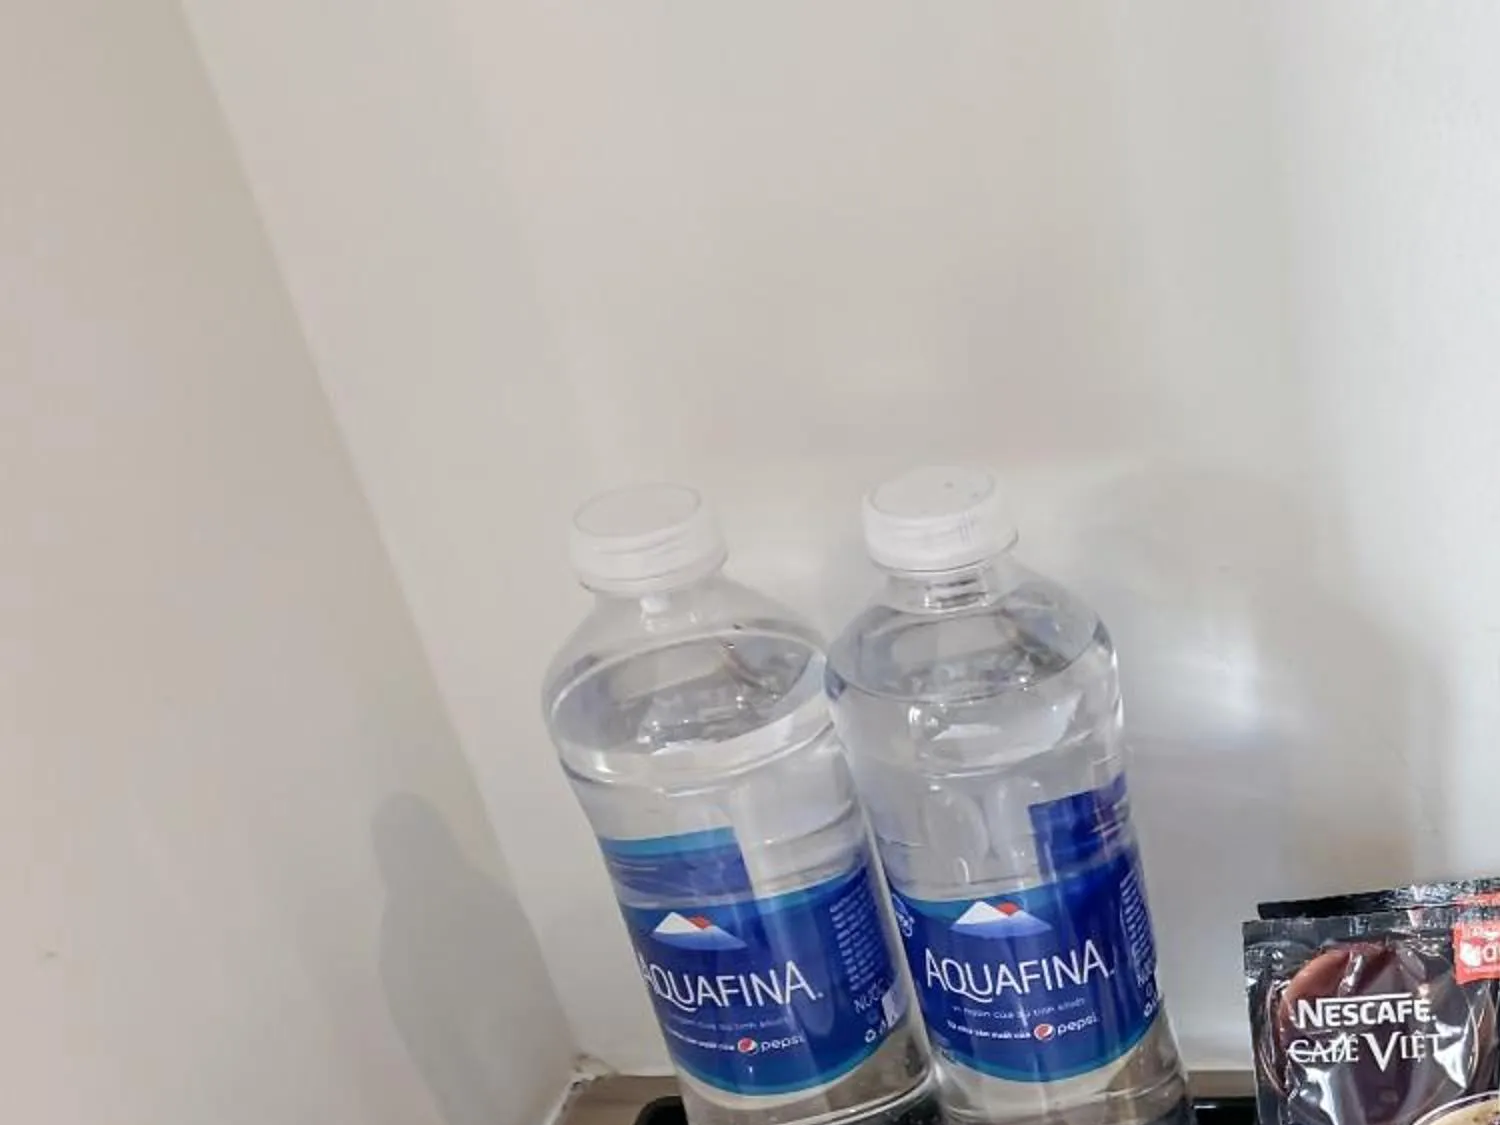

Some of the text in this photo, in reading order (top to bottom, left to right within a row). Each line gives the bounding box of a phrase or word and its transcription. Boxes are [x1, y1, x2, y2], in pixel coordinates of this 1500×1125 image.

[638, 952, 818, 1012] AQUAFINA
[926, 939, 1109, 1003] AQUAFINA
[761, 1034, 806, 1051] pepsi
[1058, 1012, 1098, 1035] pepsi
